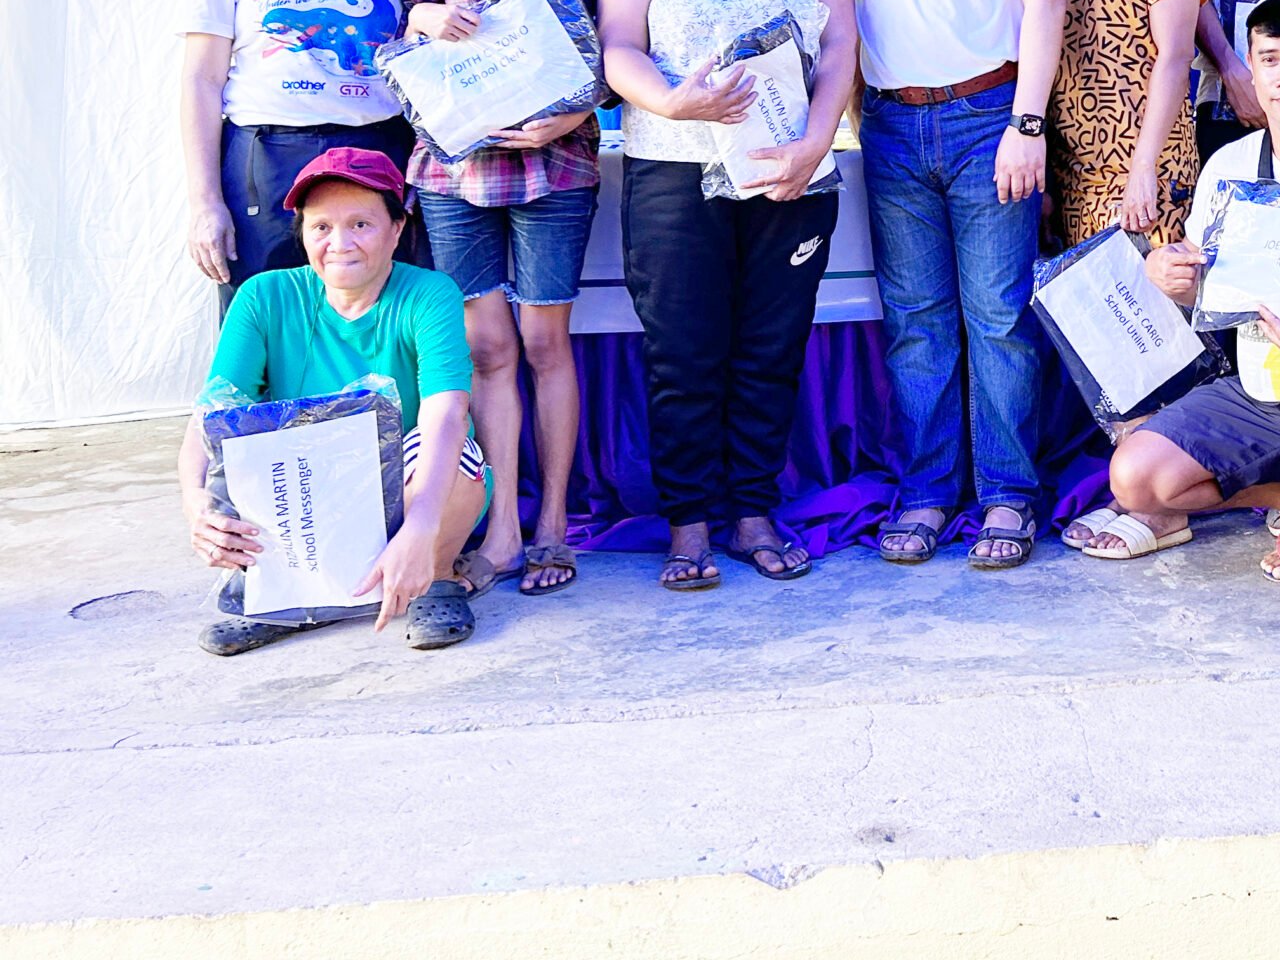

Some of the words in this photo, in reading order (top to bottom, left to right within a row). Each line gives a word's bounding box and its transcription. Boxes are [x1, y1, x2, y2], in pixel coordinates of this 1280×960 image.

[282, 80, 326, 90] brother
[440, 54, 482, 80] JUDITH
[460, 63, 498, 88] School
[500, 48, 526, 68] Clerk
[340, 85, 369, 96] GTX
[764, 77, 786, 116] EVELYN
[757, 98, 777, 133] School
[1104, 294, 1130, 326] School
[1126, 325, 1149, 354] Utility
[1115, 281, 1138, 309] LENIE
[1140, 317, 1164, 347] CARIG
[271, 462, 289, 516] MARTIN
[297, 457, 314, 530] Messenger
